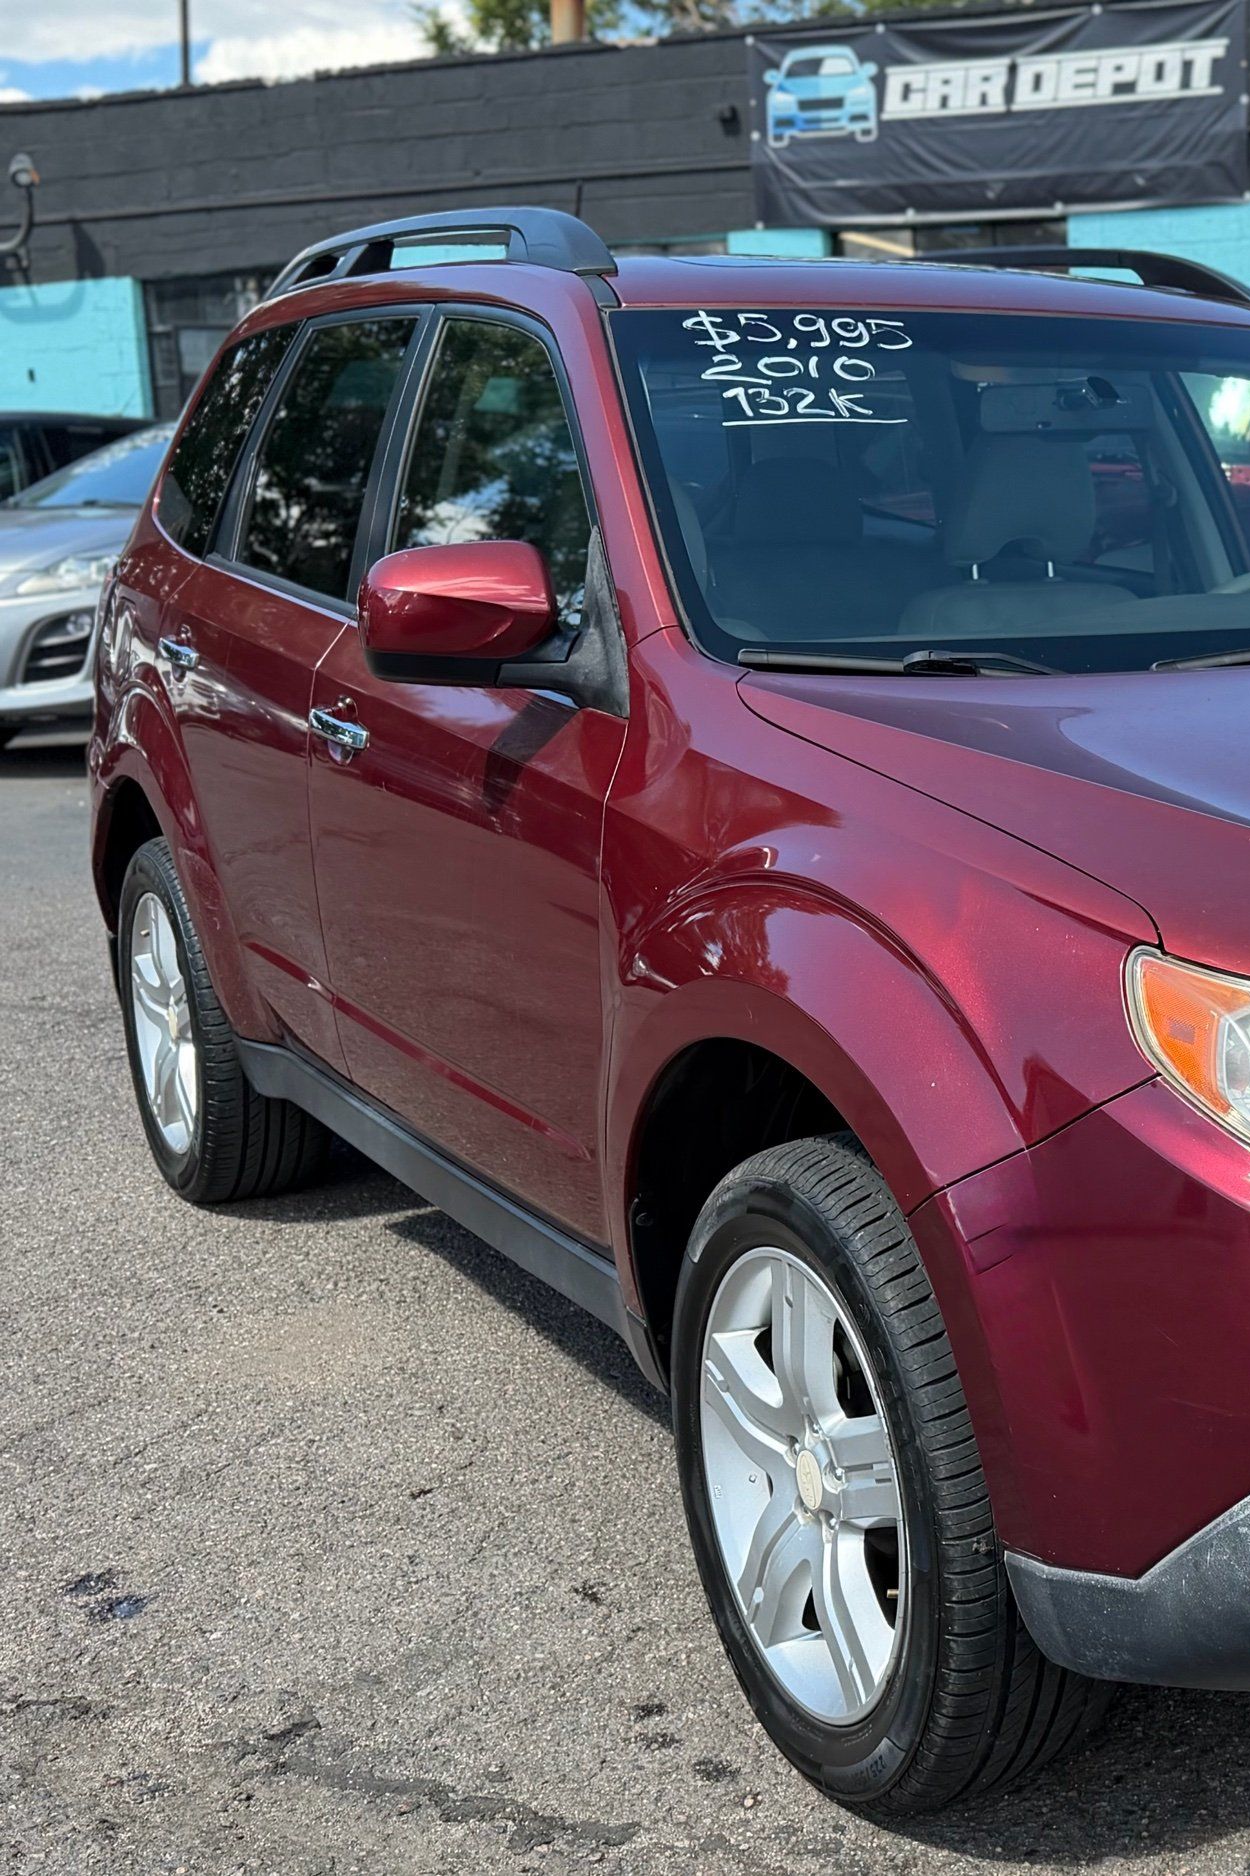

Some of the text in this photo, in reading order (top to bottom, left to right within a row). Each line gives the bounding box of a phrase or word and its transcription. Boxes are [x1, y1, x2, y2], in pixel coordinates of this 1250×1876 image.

[881, 39, 1229, 119] CAR DEPOT
[682, 310, 913, 352] $5,995
[701, 354, 876, 386] 2010
[722, 386, 873, 418] 132K
